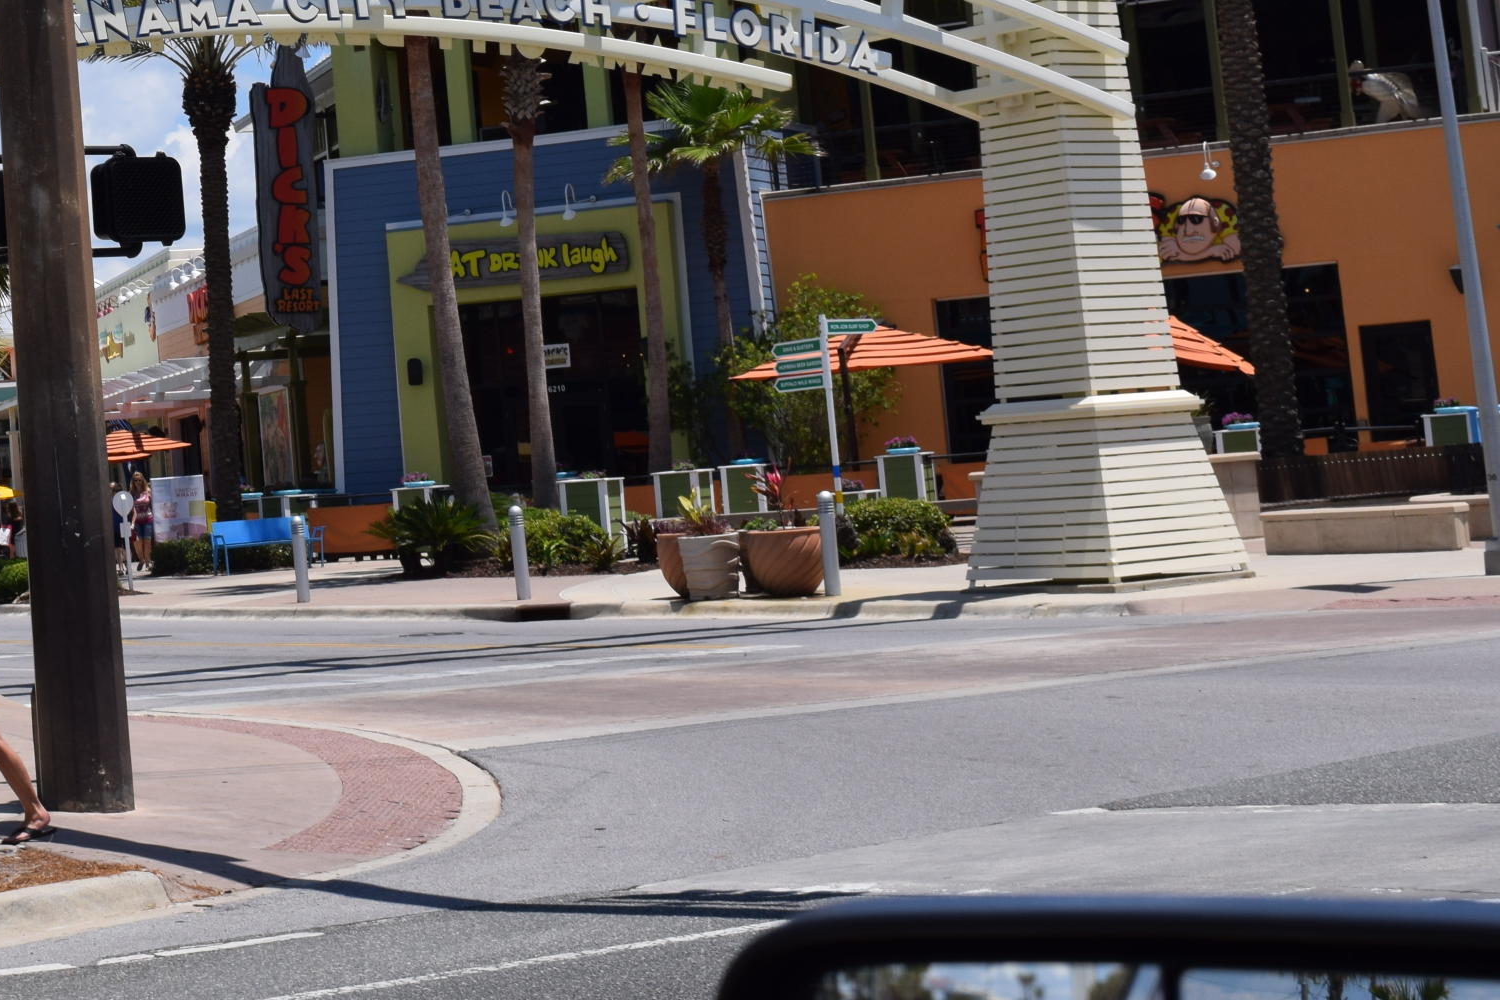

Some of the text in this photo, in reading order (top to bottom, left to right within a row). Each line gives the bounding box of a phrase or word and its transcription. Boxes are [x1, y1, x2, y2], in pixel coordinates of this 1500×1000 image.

[450, 236, 618, 278] AT DRNK laugh
[282, 287, 315, 300] LAST
[276, 300, 320, 313] RESORT
